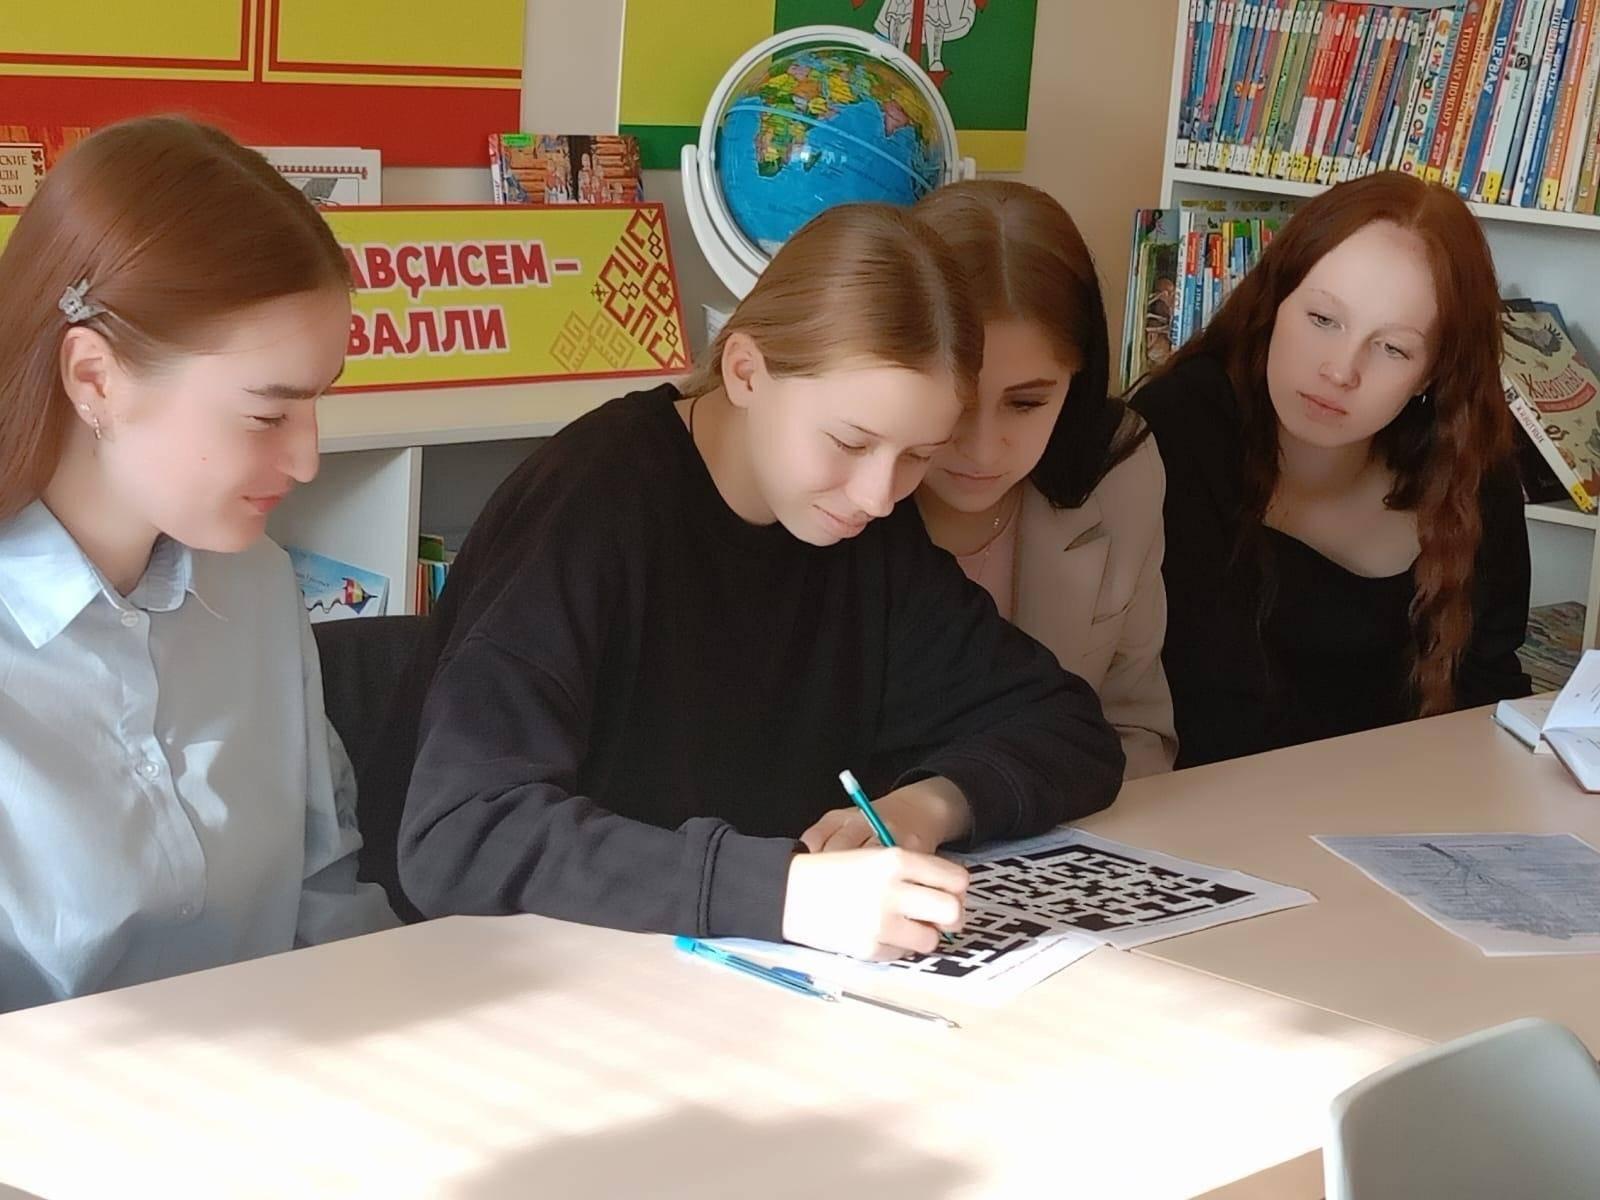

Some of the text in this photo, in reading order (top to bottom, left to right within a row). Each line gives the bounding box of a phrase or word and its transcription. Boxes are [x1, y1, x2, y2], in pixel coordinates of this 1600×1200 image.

[1458, 25, 1473, 52] ЧТО?
[1451, 53, 1466, 80] КАК?
[1482, 35, 1507, 94] ПЕРВАЯ
[1440, 81, 1459, 127] ПОЧЕМУ?
[346, 309, 507, 356] ВАЛЛИ
